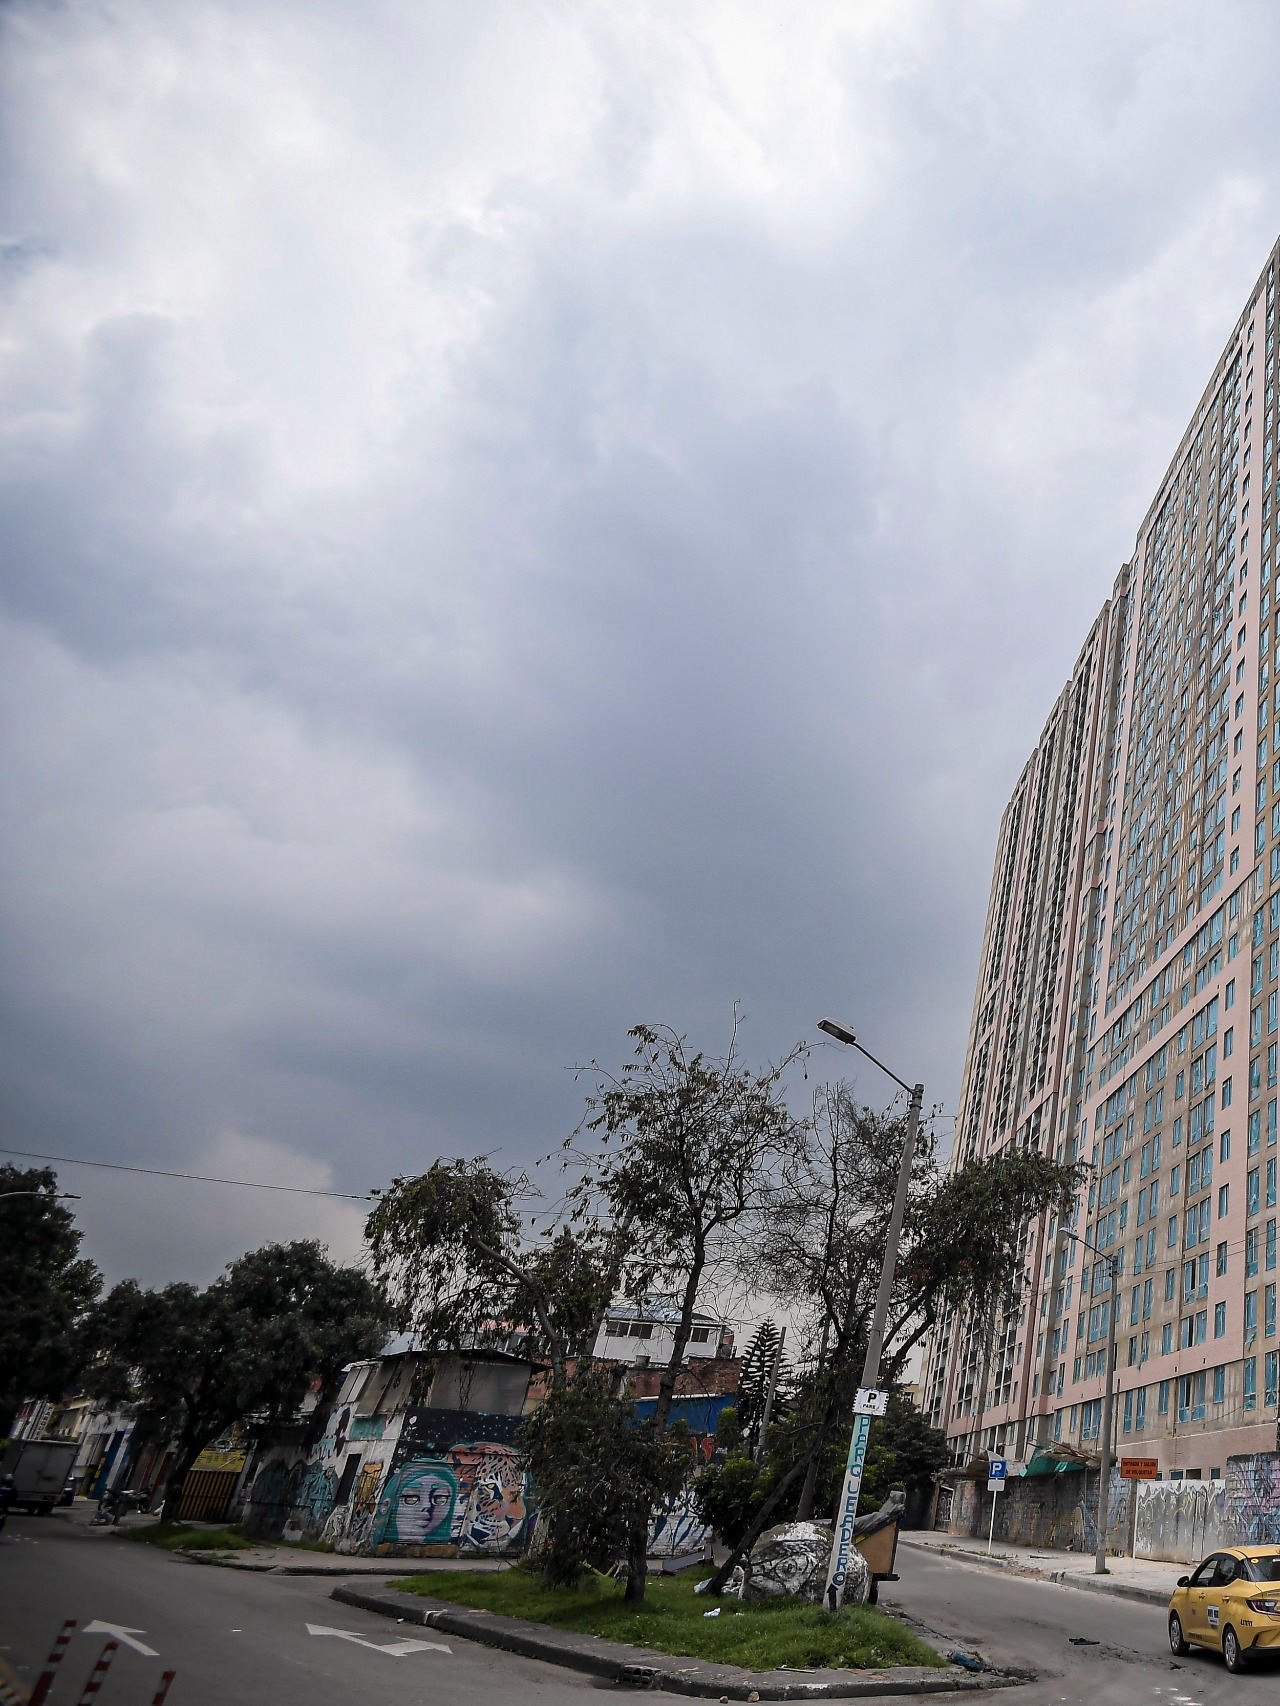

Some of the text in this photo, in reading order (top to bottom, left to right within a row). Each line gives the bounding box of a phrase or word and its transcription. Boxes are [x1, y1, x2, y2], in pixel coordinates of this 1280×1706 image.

[867, 1392, 878, 1404] P
[991, 1462, 1003, 1475] P
[832, 1416, 870, 1587] PARQUEADERO
